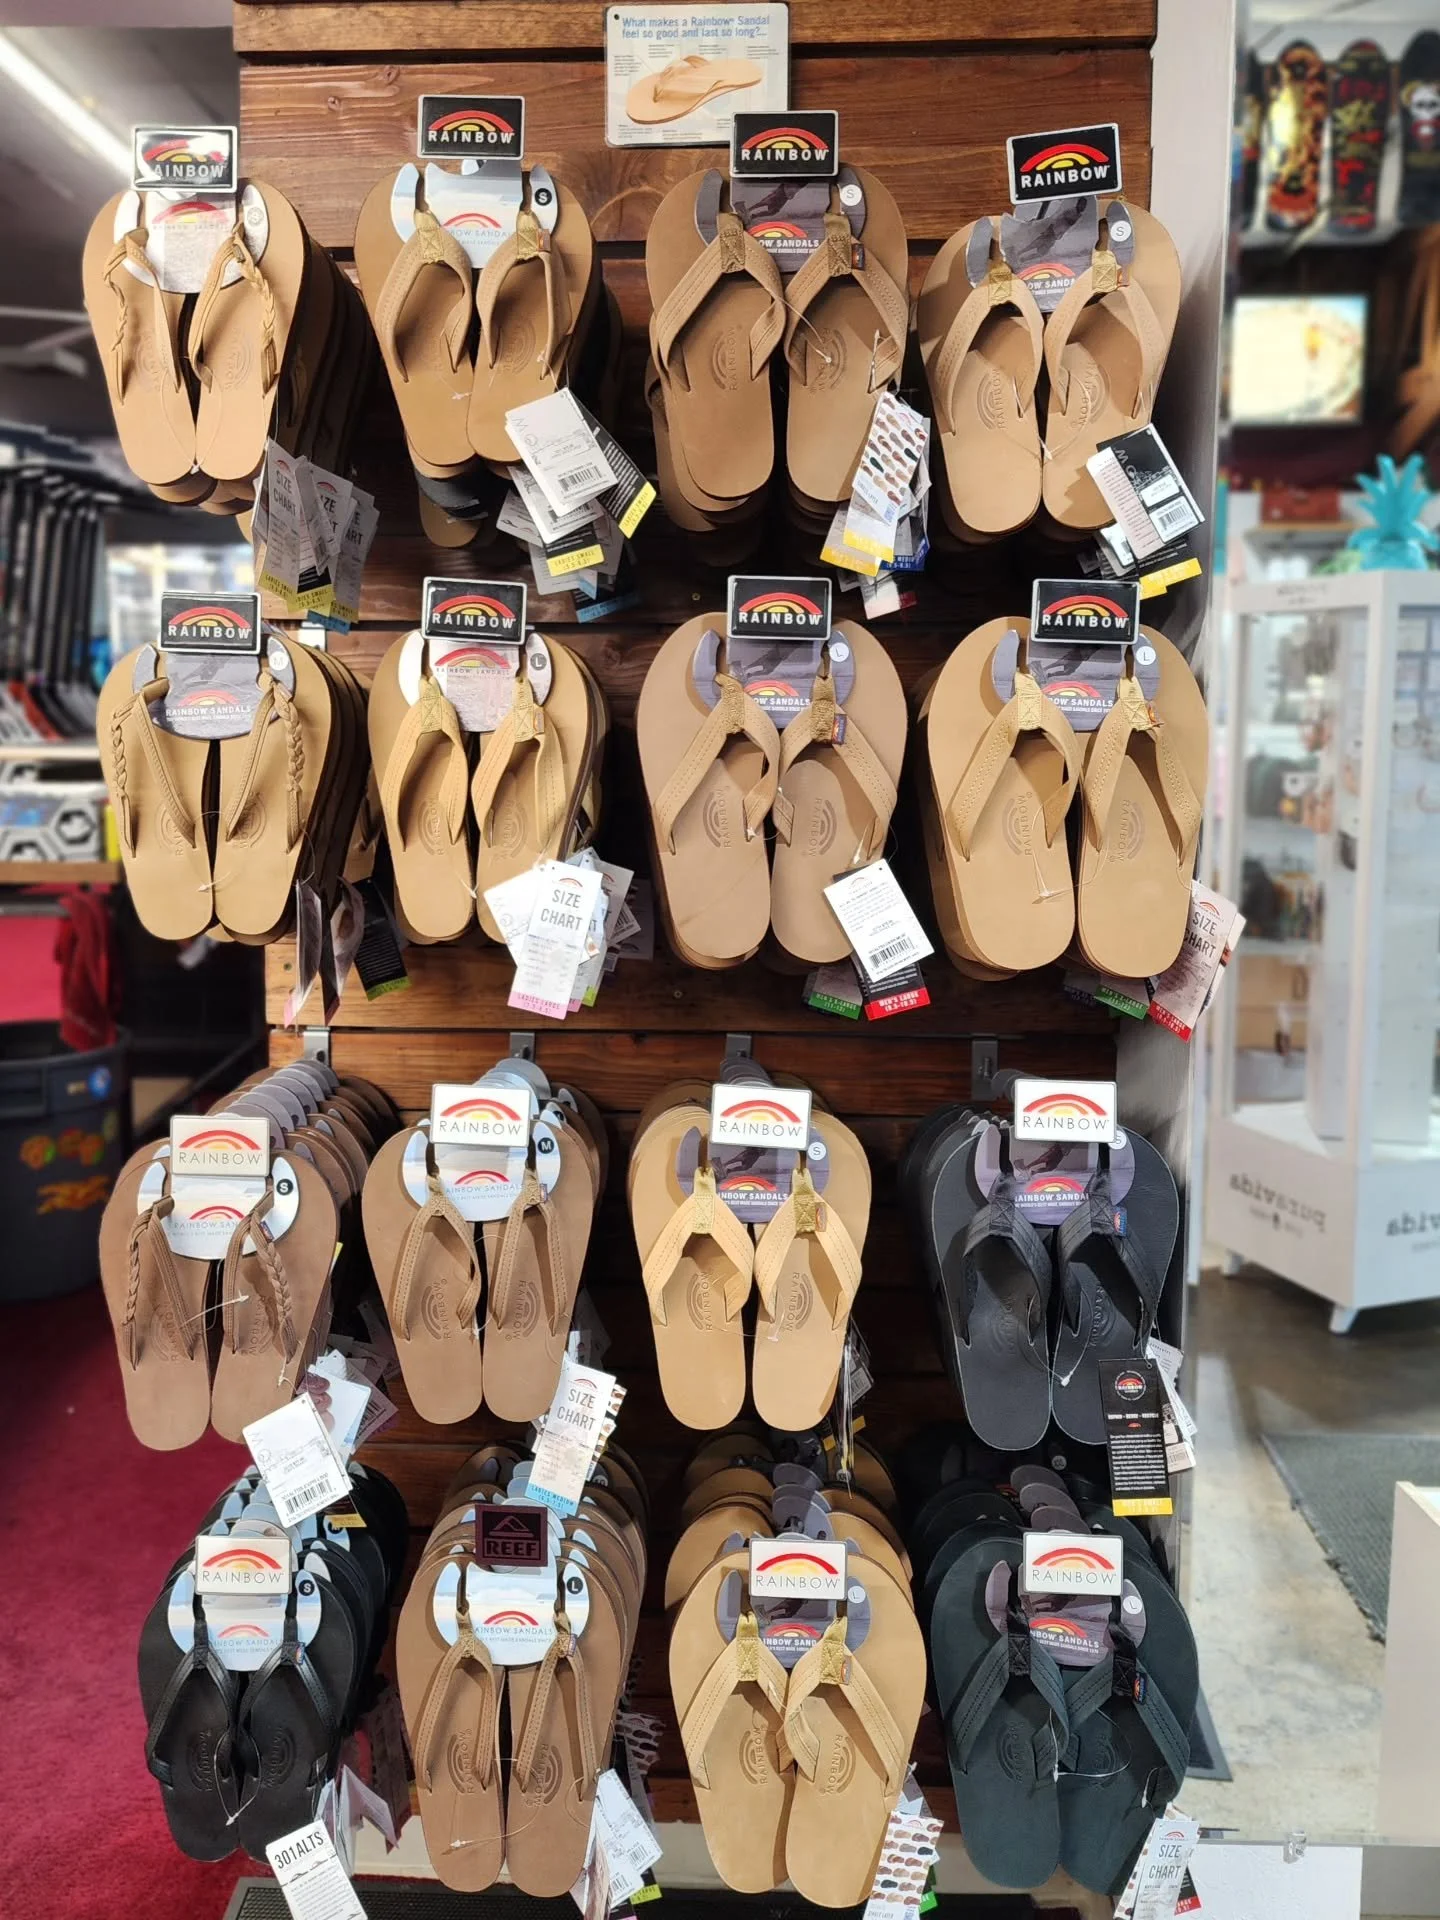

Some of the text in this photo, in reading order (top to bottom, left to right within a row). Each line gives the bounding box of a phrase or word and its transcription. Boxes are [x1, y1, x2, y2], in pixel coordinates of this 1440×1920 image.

[622, 17, 646, 28] What
[649, 16, 678, 27] makes
[737, 15, 770, 26] Sandal
[622, 28, 640, 39] feel
[643, 30, 653, 38] so
[656, 28, 680, 40] good
[682, 27, 698, 38] and
[701, 27, 719, 38] last
[722, 28, 732, 37] so
[428, 130, 514, 144] RAINBOW
[741, 148, 829, 162] RAINBOW
[151, 164, 225, 178] AINBOW
[1021, 165, 1109, 189] RAINBOW
[538, 192, 548, 203] S
[846, 189, 855, 199] S
[1116, 226, 1125, 237] S
[776, 239, 820, 248] SANDALS
[276, 470, 292, 495] SIZE
[273, 487, 297, 517] CHART
[432, 612, 515, 629] RAINBOW
[739, 612, 822, 626] RAINBOW
[1042, 614, 1128, 629] RAINBOW
[168, 624, 252, 639] RAINBOW
[535, 656, 542, 668] L
[1143, 652, 1150, 661] L
[436, 667, 470, 675] RANBOW
[770, 698, 811, 706] SANDALS
[1071, 699, 1113, 707] SANDALS
[166, 705, 251, 717] RAINBOW SANDALS
[808, 797, 822, 857] RAINBOW
[1019, 794, 1032, 856] RAINBOW
[1116, 799, 1129, 862] RAINBOW
[552, 888, 581, 909] SIZE
[541, 908, 583, 931] CHART
[1193, 911, 1217, 937] SIZE
[1184, 929, 1217, 958] CHART
[439, 1120, 522, 1136] RAINBOW
[719, 1120, 802, 1137] RAINBOW
[1023, 1115, 1109, 1131] RAINBOW
[540, 1141, 551, 1151] M
[813, 1146, 821, 1156] S
[179, 1151, 262, 1165] RAINBOW
[280, 1182, 288, 1194] S
[446, 1186, 480, 1194] AINBOW
[719, 1192, 788, 1201] INBOW SANDALS
[174, 1221, 215, 1230] RAINBOW
[700, 1271, 713, 1331] RAINBOW
[787, 1271, 800, 1332] RAINBOW
[434, 1281, 451, 1340] RAINBOW
[514, 1280, 527, 1340] RAINBOW
[568, 1388, 596, 1409] SIZE
[557, 1406, 596, 1431] CHART
[531, 1485, 552, 1497] LADIES
[485, 1540, 537, 1556] REEF
[202, 1570, 283, 1584] RAINBOW
[756, 1575, 840, 1589] RAINBOW
[1032, 1569, 1116, 1585] RAINBOW
[303, 1583, 311, 1593] S
[571, 1581, 579, 1592] L
[1129, 1601, 1138, 1610] L
[475, 1627, 552, 1636] AINBOW SANDALS
[763, 1638, 792, 1646] INBOW
[1059, 1634, 1100, 1649] SANDALS
[754, 1725, 768, 1784] RAINBOW
[460, 1730, 473, 1794] RAINBOW
[824, 1734, 842, 1794] RAINBOW
[274, 1831, 324, 1869] 301ALTS
[1158, 1844, 1182, 1858] SIZE
[1149, 1865, 1181, 1879] CHART
